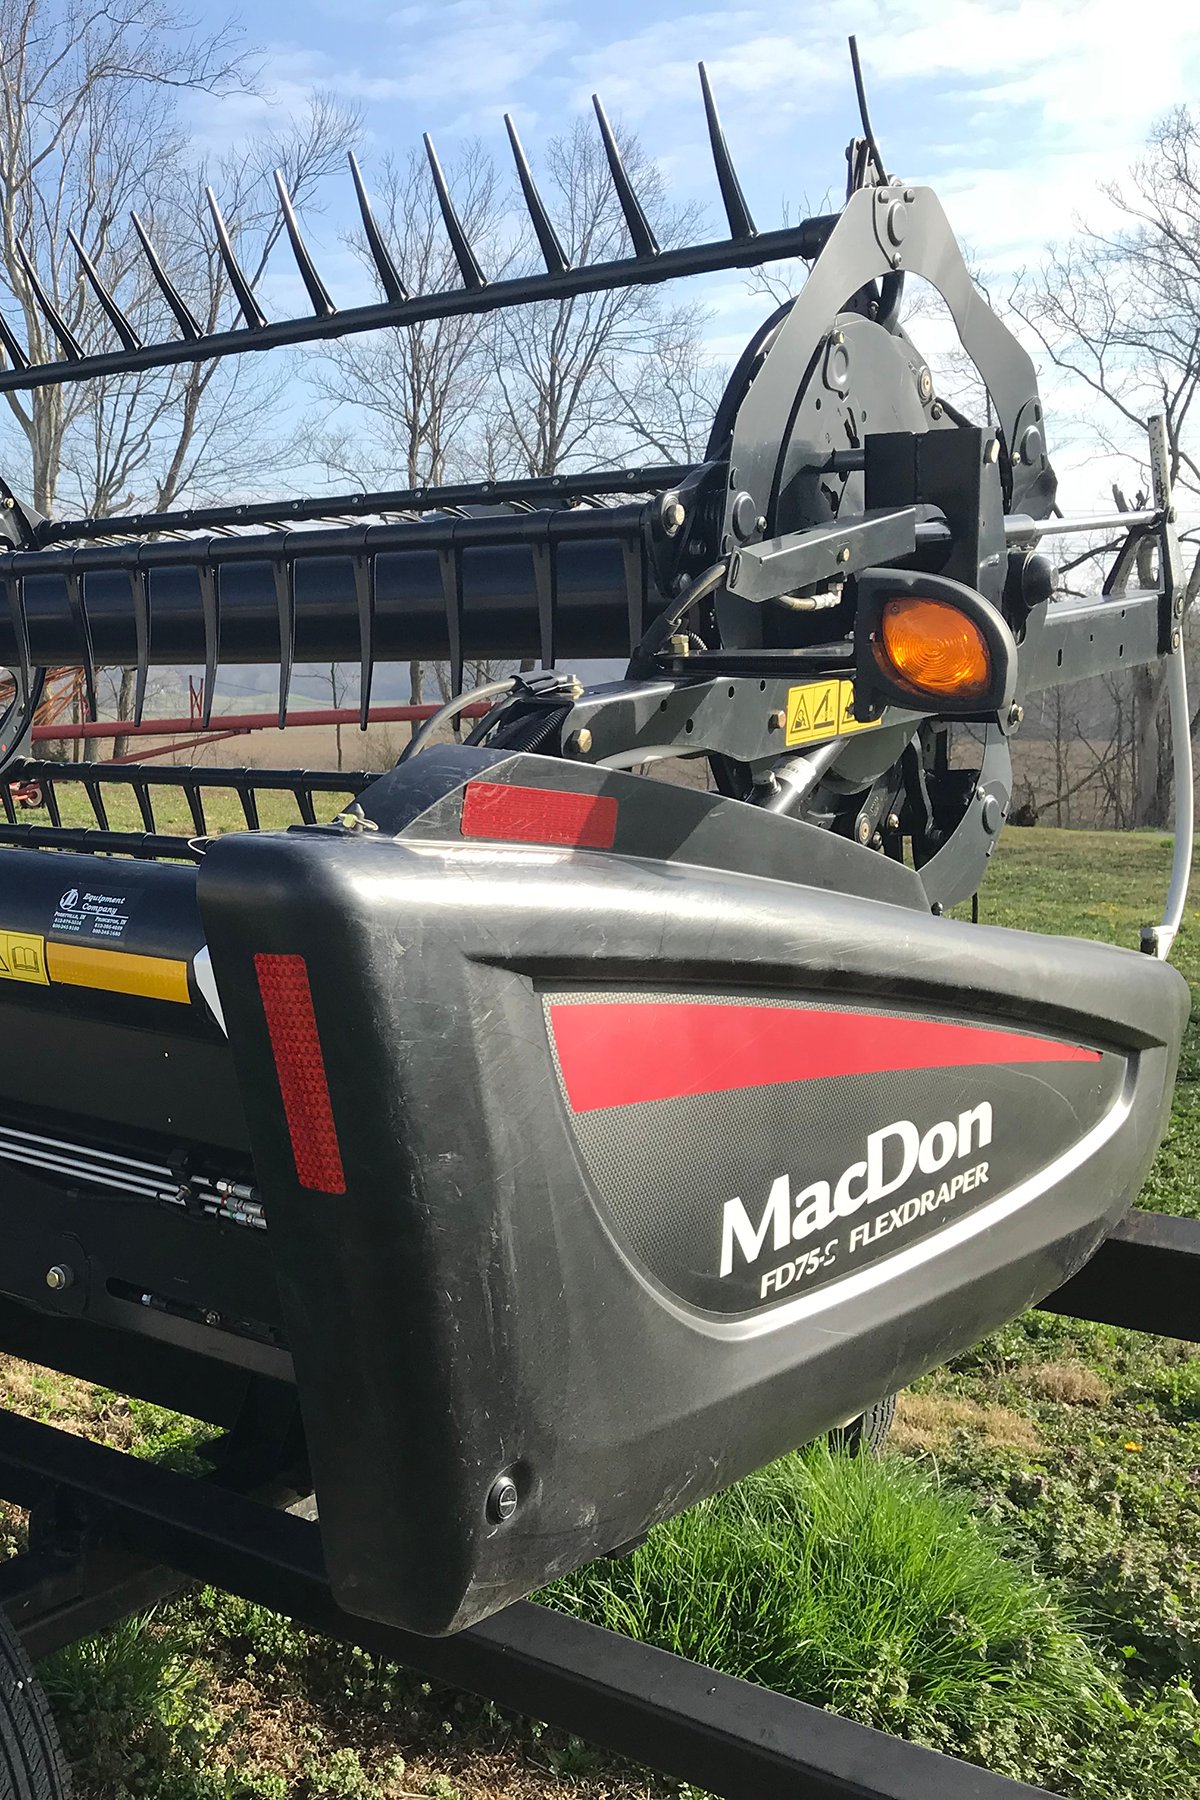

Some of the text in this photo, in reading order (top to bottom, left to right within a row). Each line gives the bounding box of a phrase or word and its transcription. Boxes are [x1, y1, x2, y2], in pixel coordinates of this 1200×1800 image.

[81, 902, 118, 916] Company
[82, 892, 126, 905] Equipment
[719, 1100, 993, 1278] MacDon
[849, 1161, 990, 1254] FLEXDRAPER
